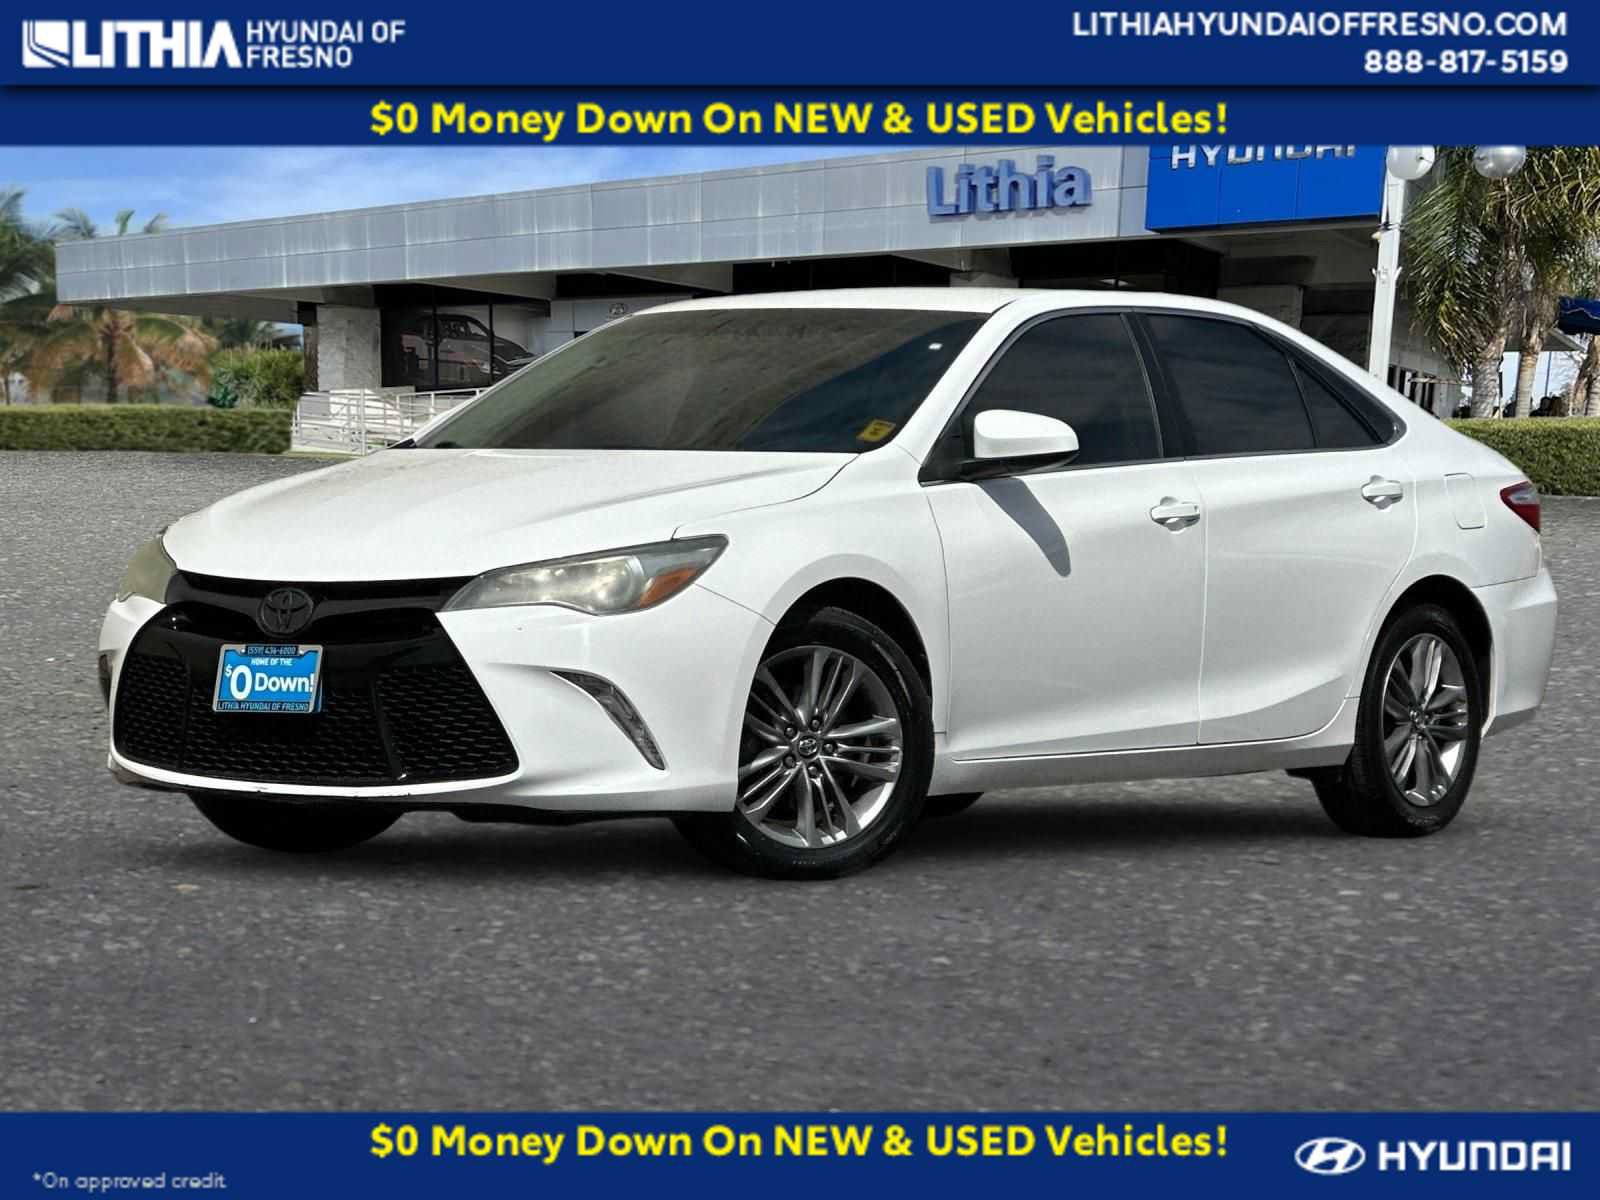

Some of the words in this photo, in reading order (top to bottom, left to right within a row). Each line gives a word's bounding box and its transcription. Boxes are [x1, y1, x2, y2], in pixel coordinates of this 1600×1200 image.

[926, 155, 1092, 218] Lithia
[250, 657, 269, 666] HOME
[270, 657, 280, 666] OF
[280, 657, 294, 666] THE
[255, 673, 314, 693] Down!
[271, 701, 282, 711] OF
